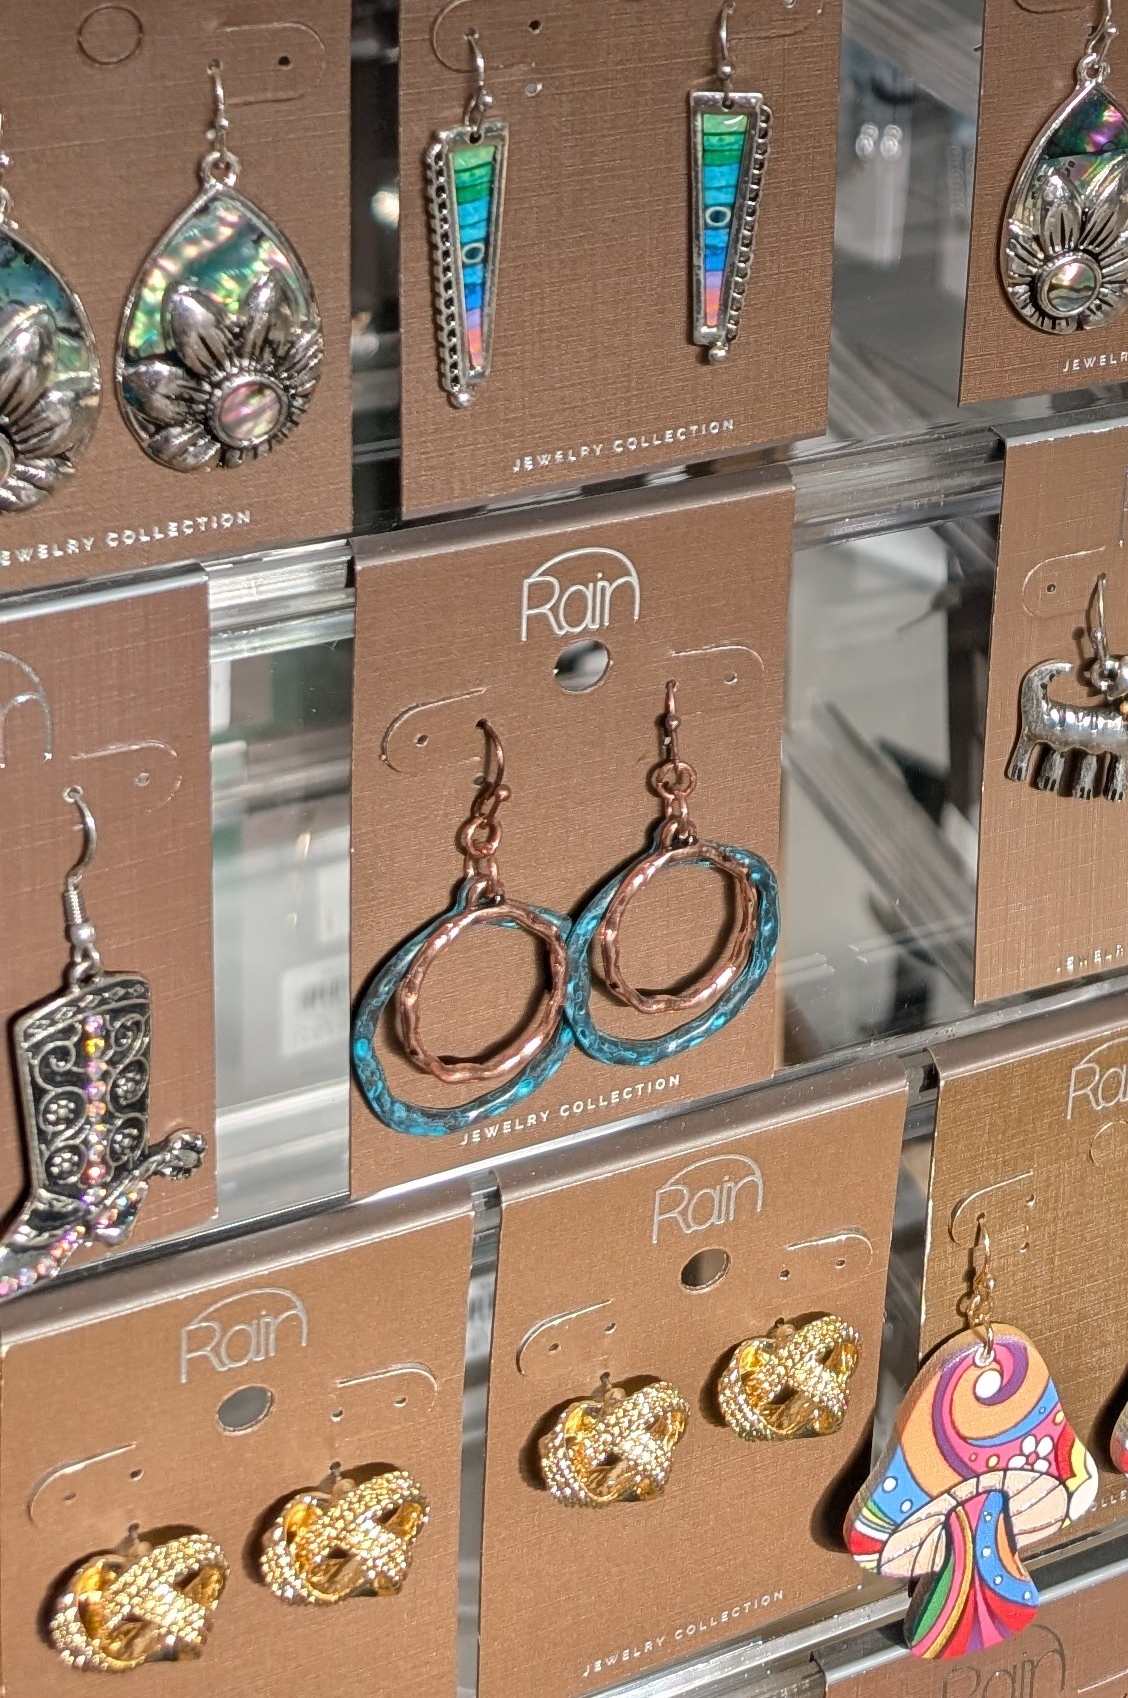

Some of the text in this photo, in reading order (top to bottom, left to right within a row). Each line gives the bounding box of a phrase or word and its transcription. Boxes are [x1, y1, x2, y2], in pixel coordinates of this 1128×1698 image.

[512, 418, 734, 473] JEWELRY COLLECTION
[105, 509, 250, 548] COLLECTION
[520, 546, 641, 642] Rain
[459, 1074, 681, 1146] JEWELRY COLLECTION
[652, 1153, 764, 1244] Rain
[180, 1286, 309, 1385] Rain
[582, 1589, 784, 1678] JEWELRY COLLECTION
